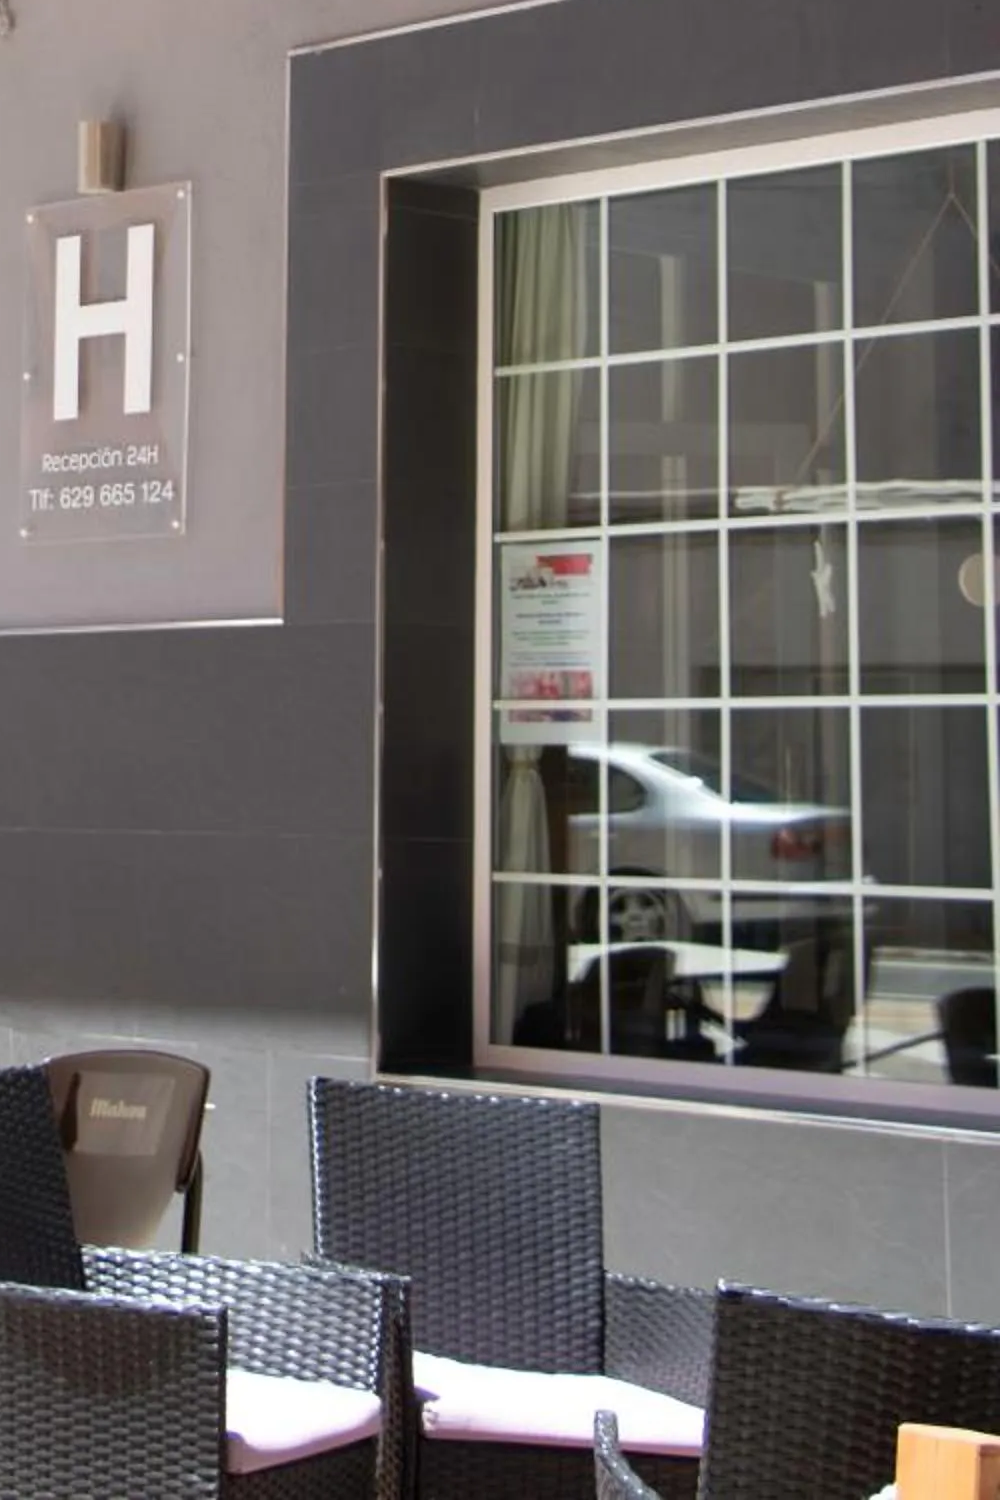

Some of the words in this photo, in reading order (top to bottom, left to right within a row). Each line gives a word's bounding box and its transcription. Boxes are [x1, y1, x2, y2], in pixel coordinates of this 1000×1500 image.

[53, 223, 155, 421] H
[126, 444, 159, 467] 24H
[60, 484, 95, 510] 629
[100, 483, 136, 507] 665
[141, 479, 174, 503] 124
[88, 1097, 147, 1119] Mahou
